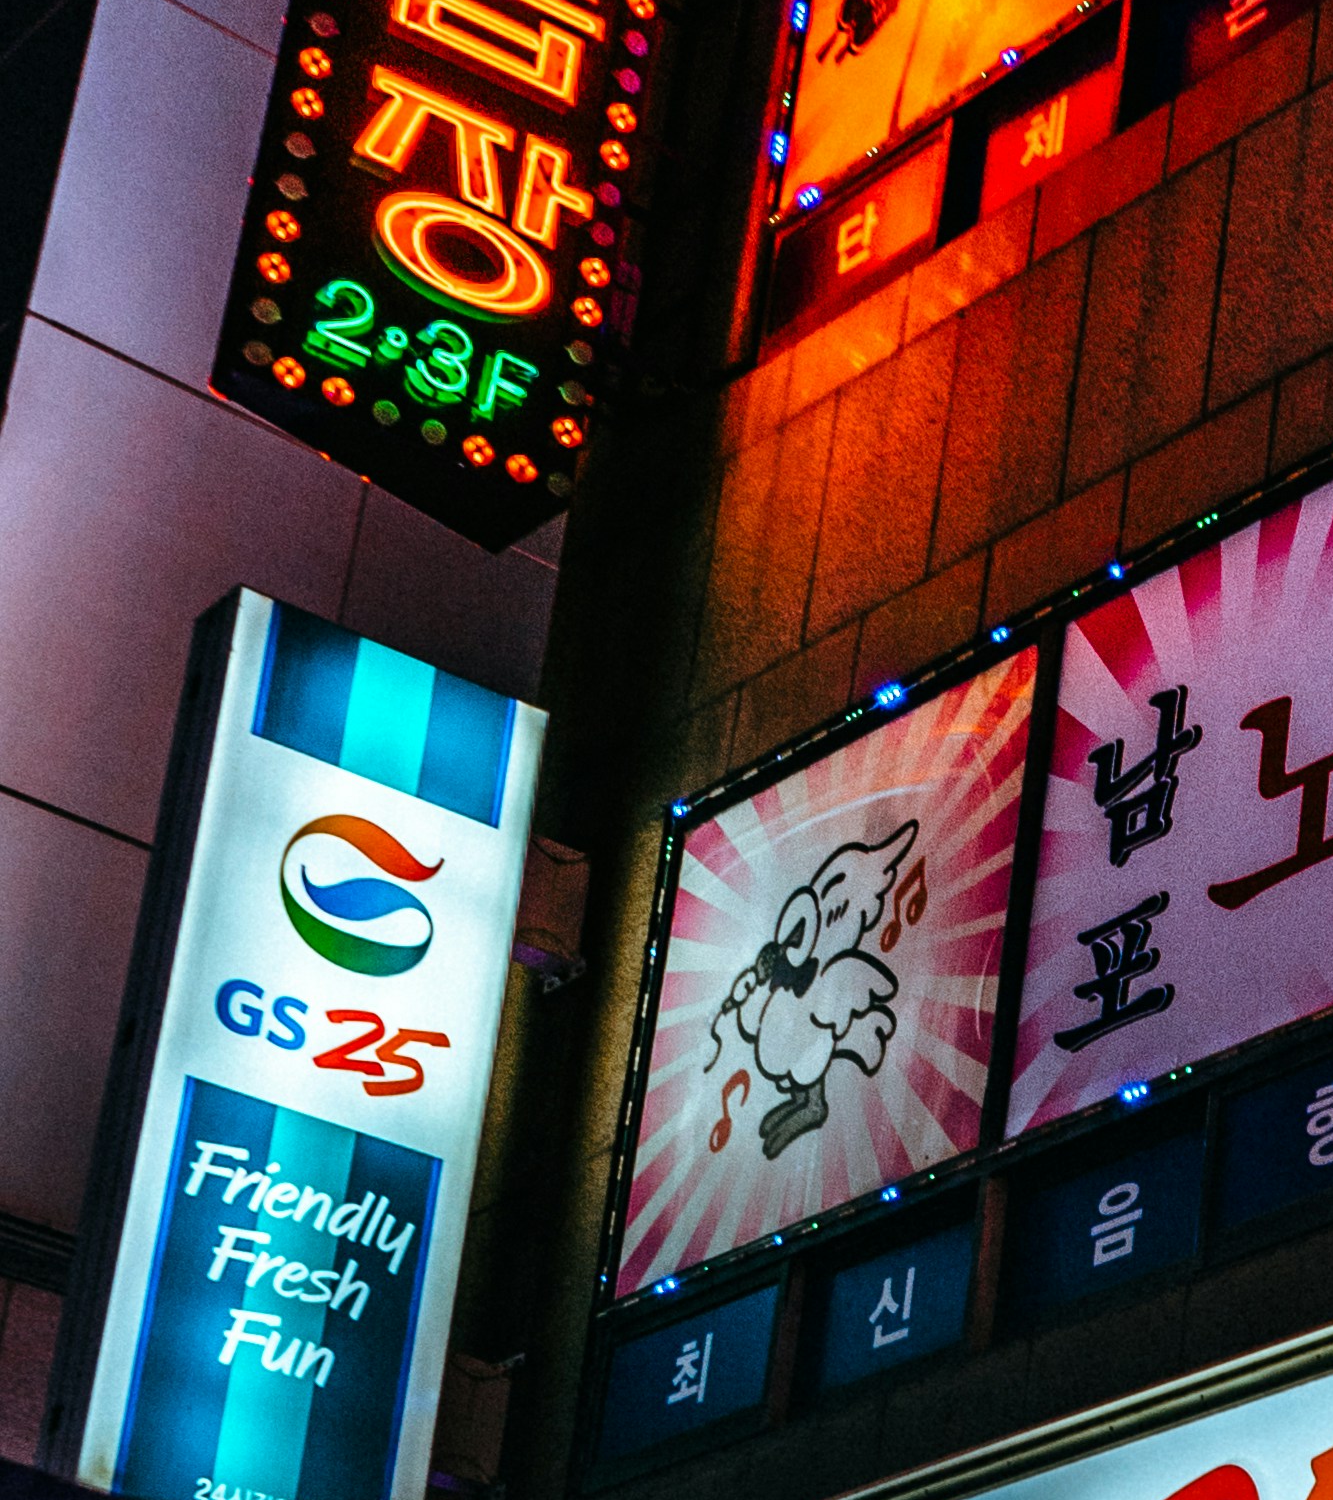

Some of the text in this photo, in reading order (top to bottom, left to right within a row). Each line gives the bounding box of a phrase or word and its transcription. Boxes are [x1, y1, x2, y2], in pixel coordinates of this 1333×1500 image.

[1053, 683, 1202, 1055] 남포
[183, 1140, 415, 1272] Friendly
[203, 1226, 371, 1323] Fresh
[217, 1307, 336, 1389] Fun
